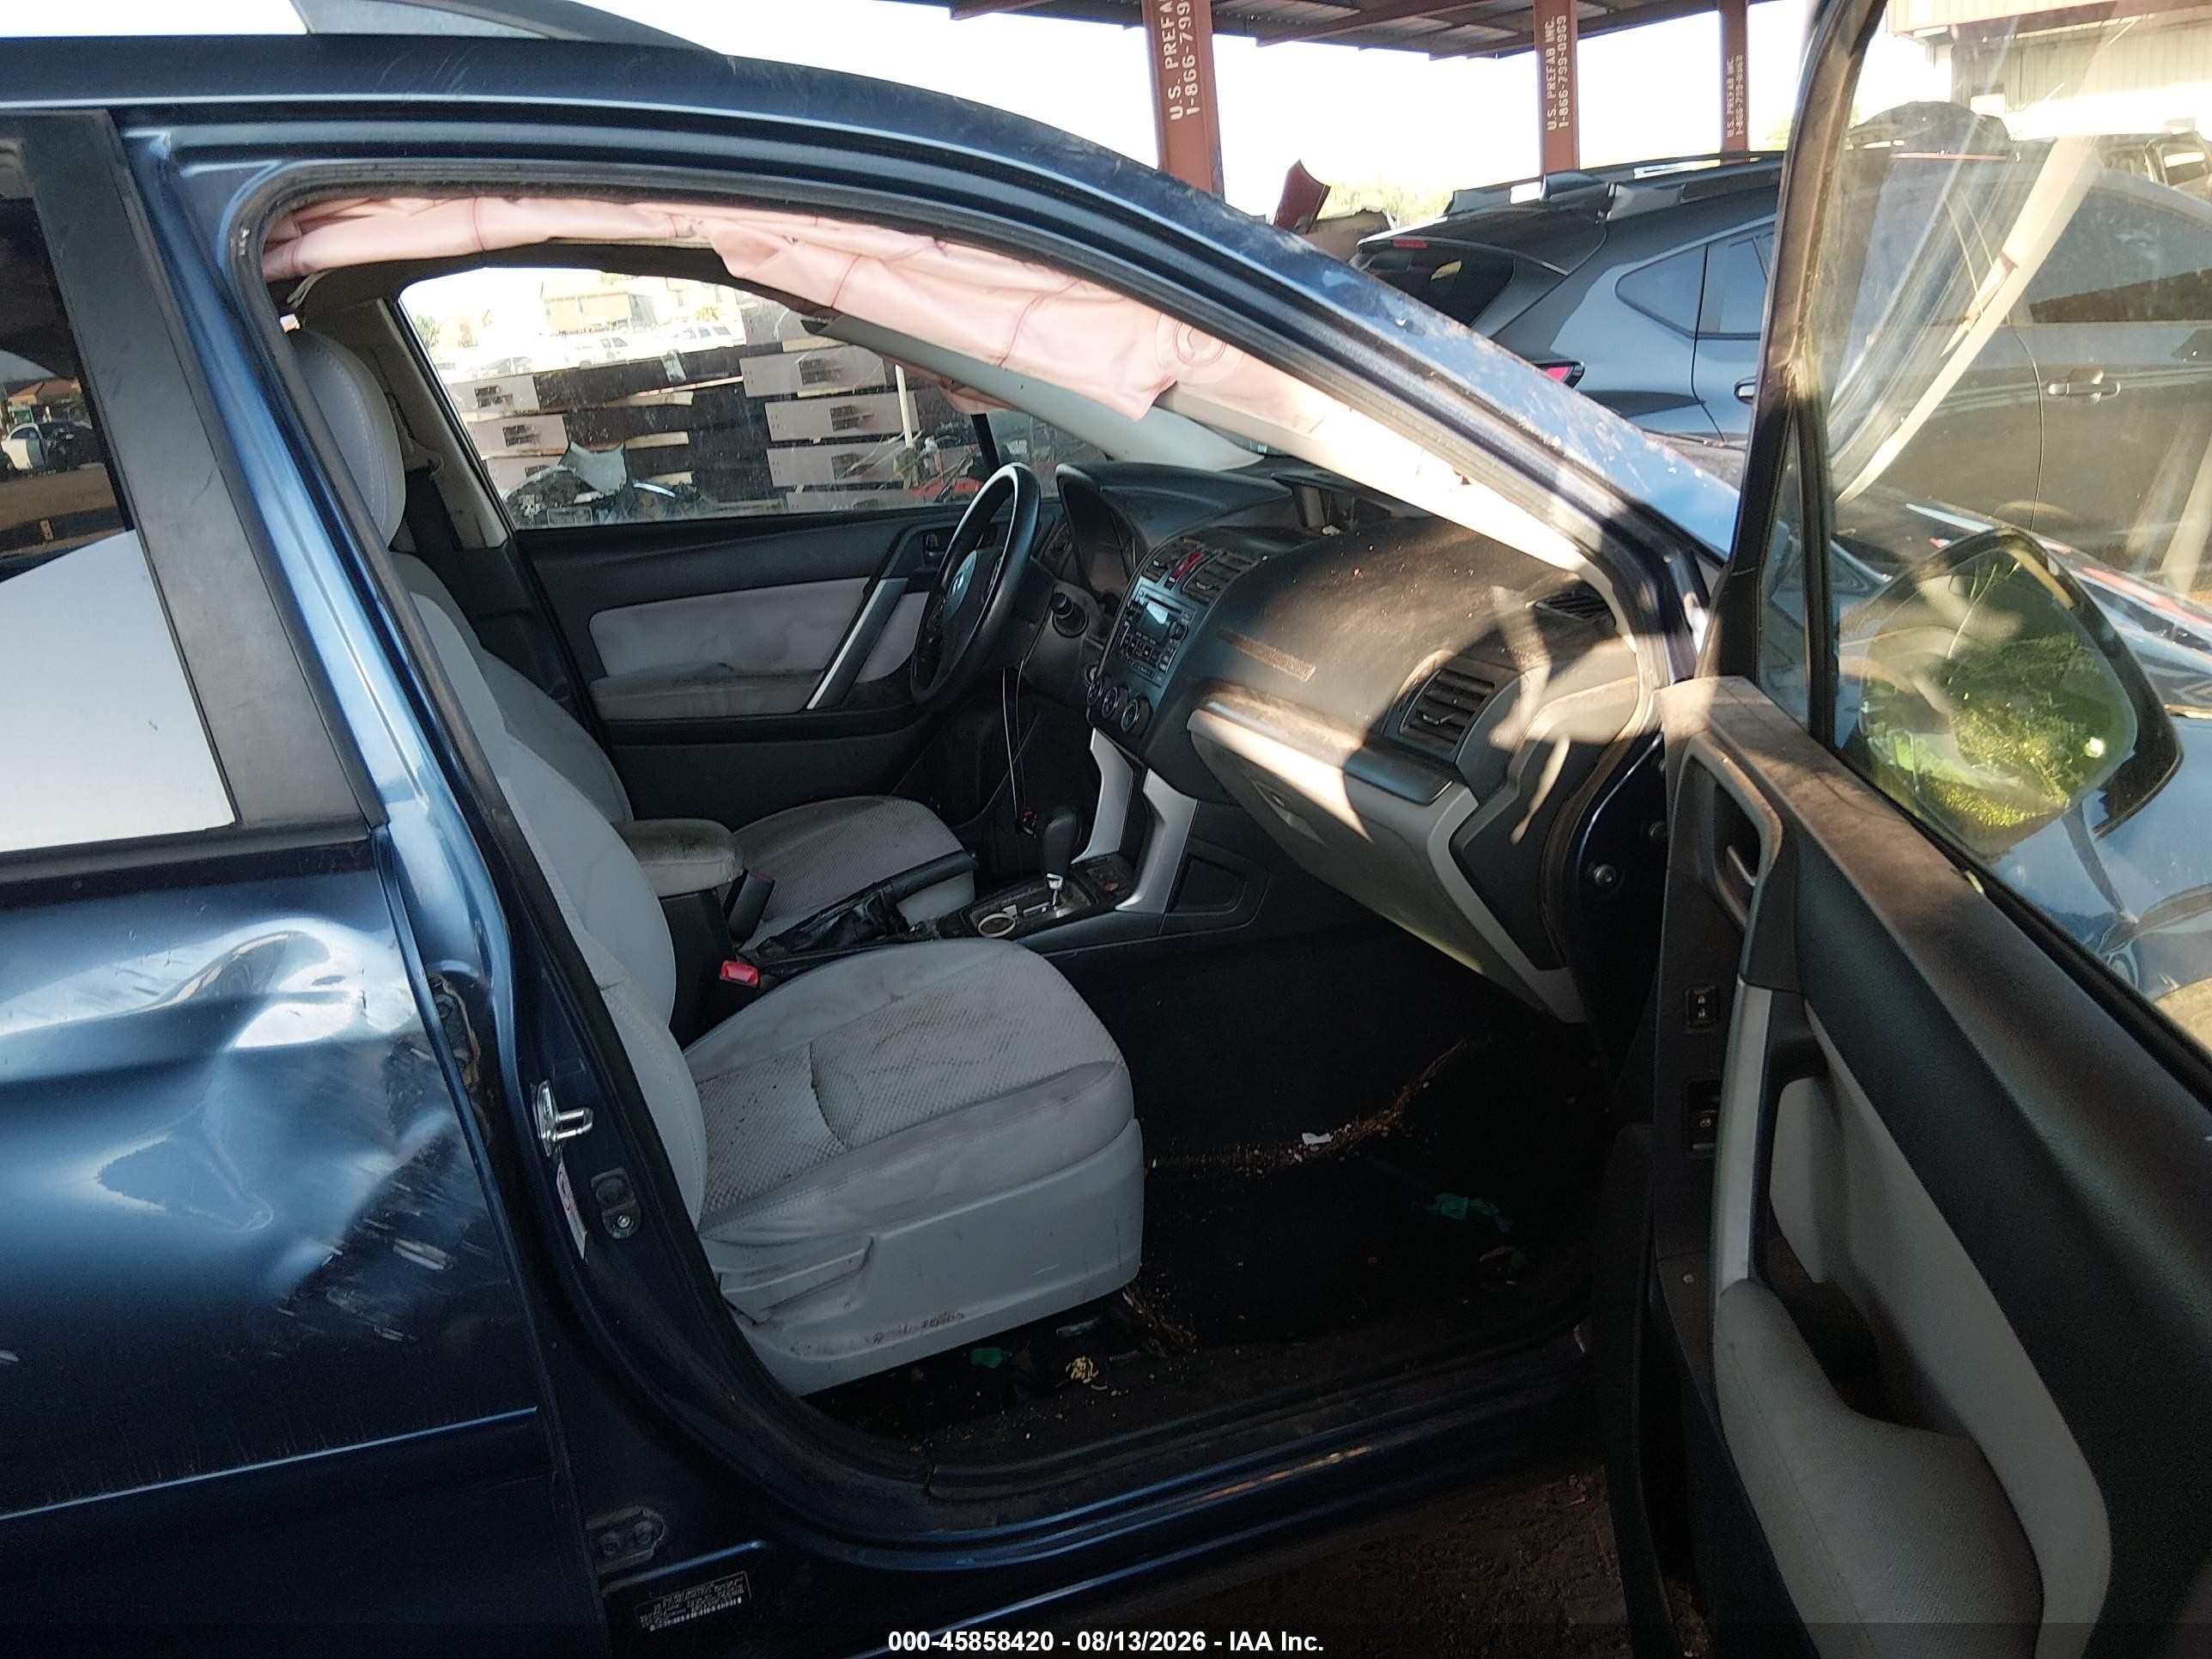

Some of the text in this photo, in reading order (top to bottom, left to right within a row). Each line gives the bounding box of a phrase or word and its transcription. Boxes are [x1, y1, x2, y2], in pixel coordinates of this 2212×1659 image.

[1158, 0, 1183, 120] U.S. PREFA
[1176, 0, 1200, 115] 1-866-799
[1545, 15, 1557, 131] U.S. PREFAB INC.
